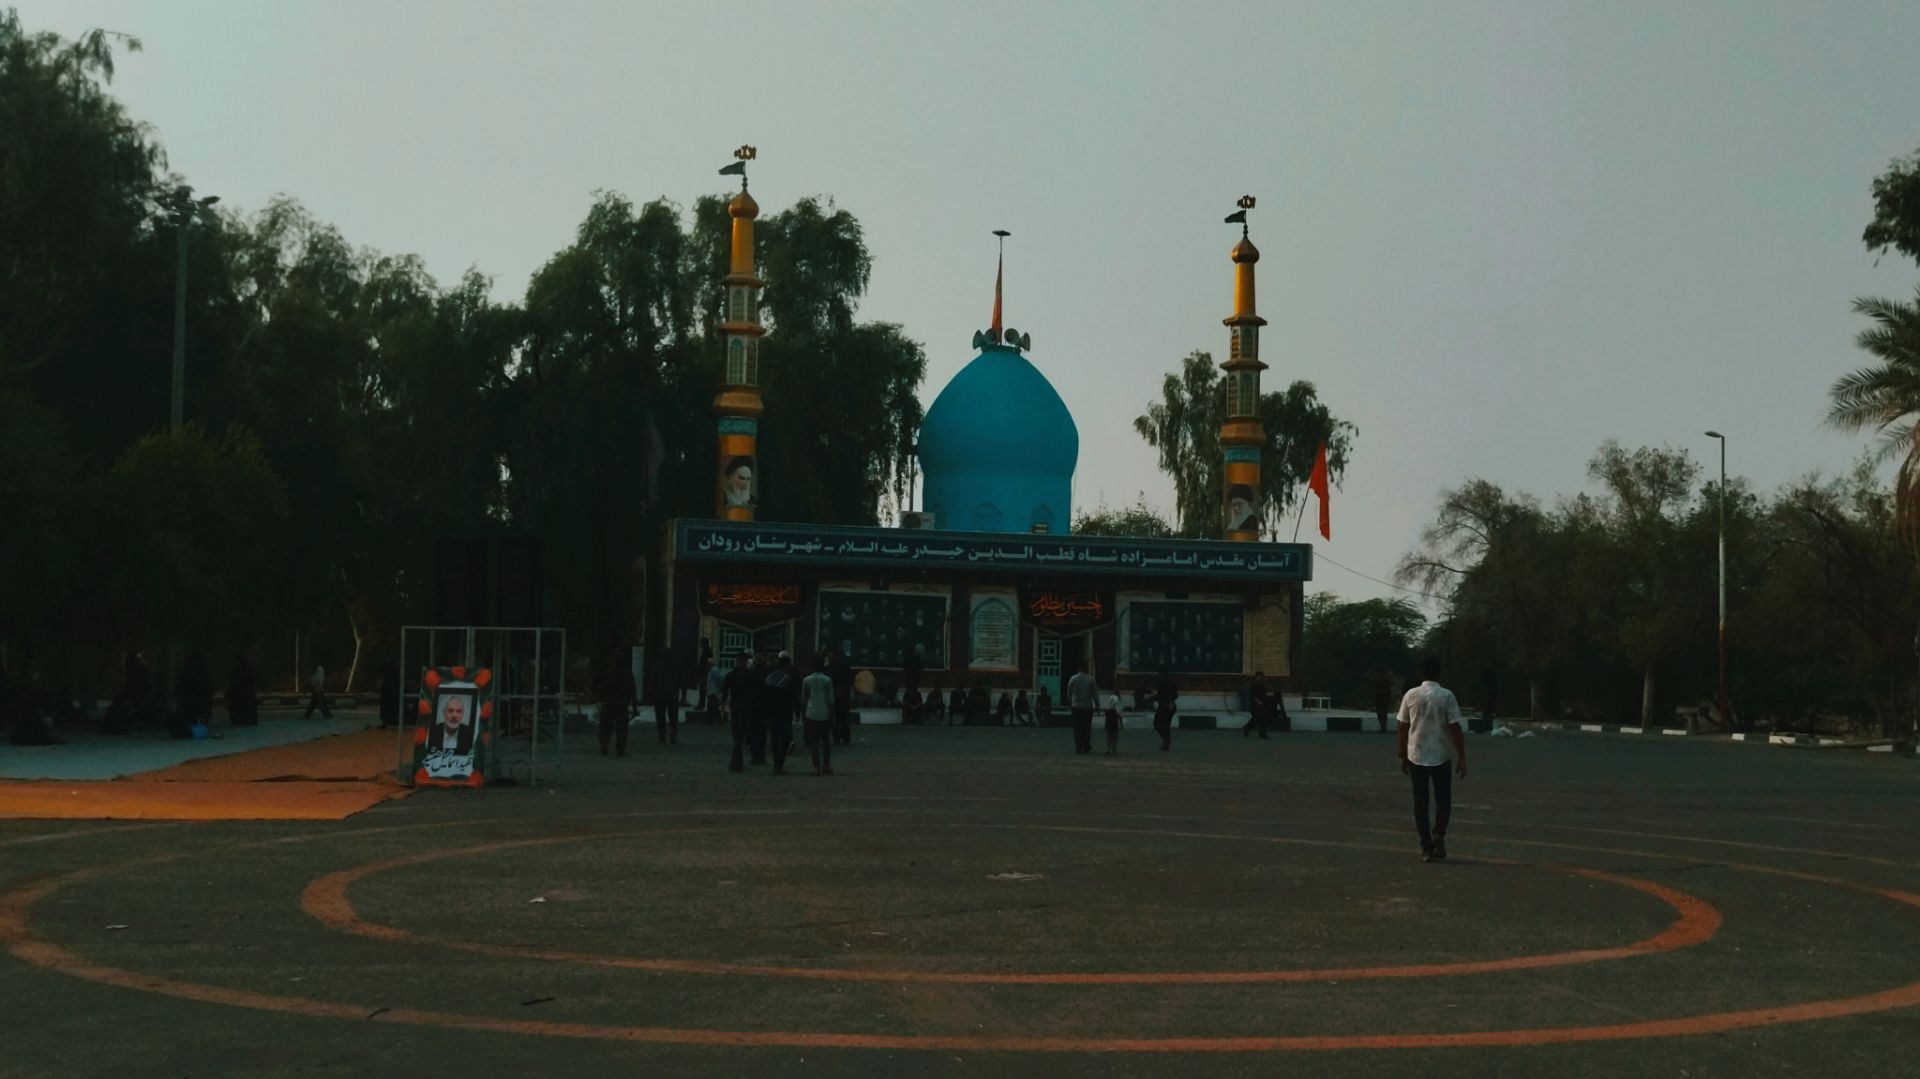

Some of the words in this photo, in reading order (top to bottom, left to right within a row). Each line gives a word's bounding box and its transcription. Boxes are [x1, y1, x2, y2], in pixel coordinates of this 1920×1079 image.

[699, 532, 740, 551] رودان
[912, 544, 964, 559] حیدر
[1036, 546, 1075, 564] قطب
[1079, 548, 1117, 562] شاه
[1201, 552, 1244, 570] مقدس
